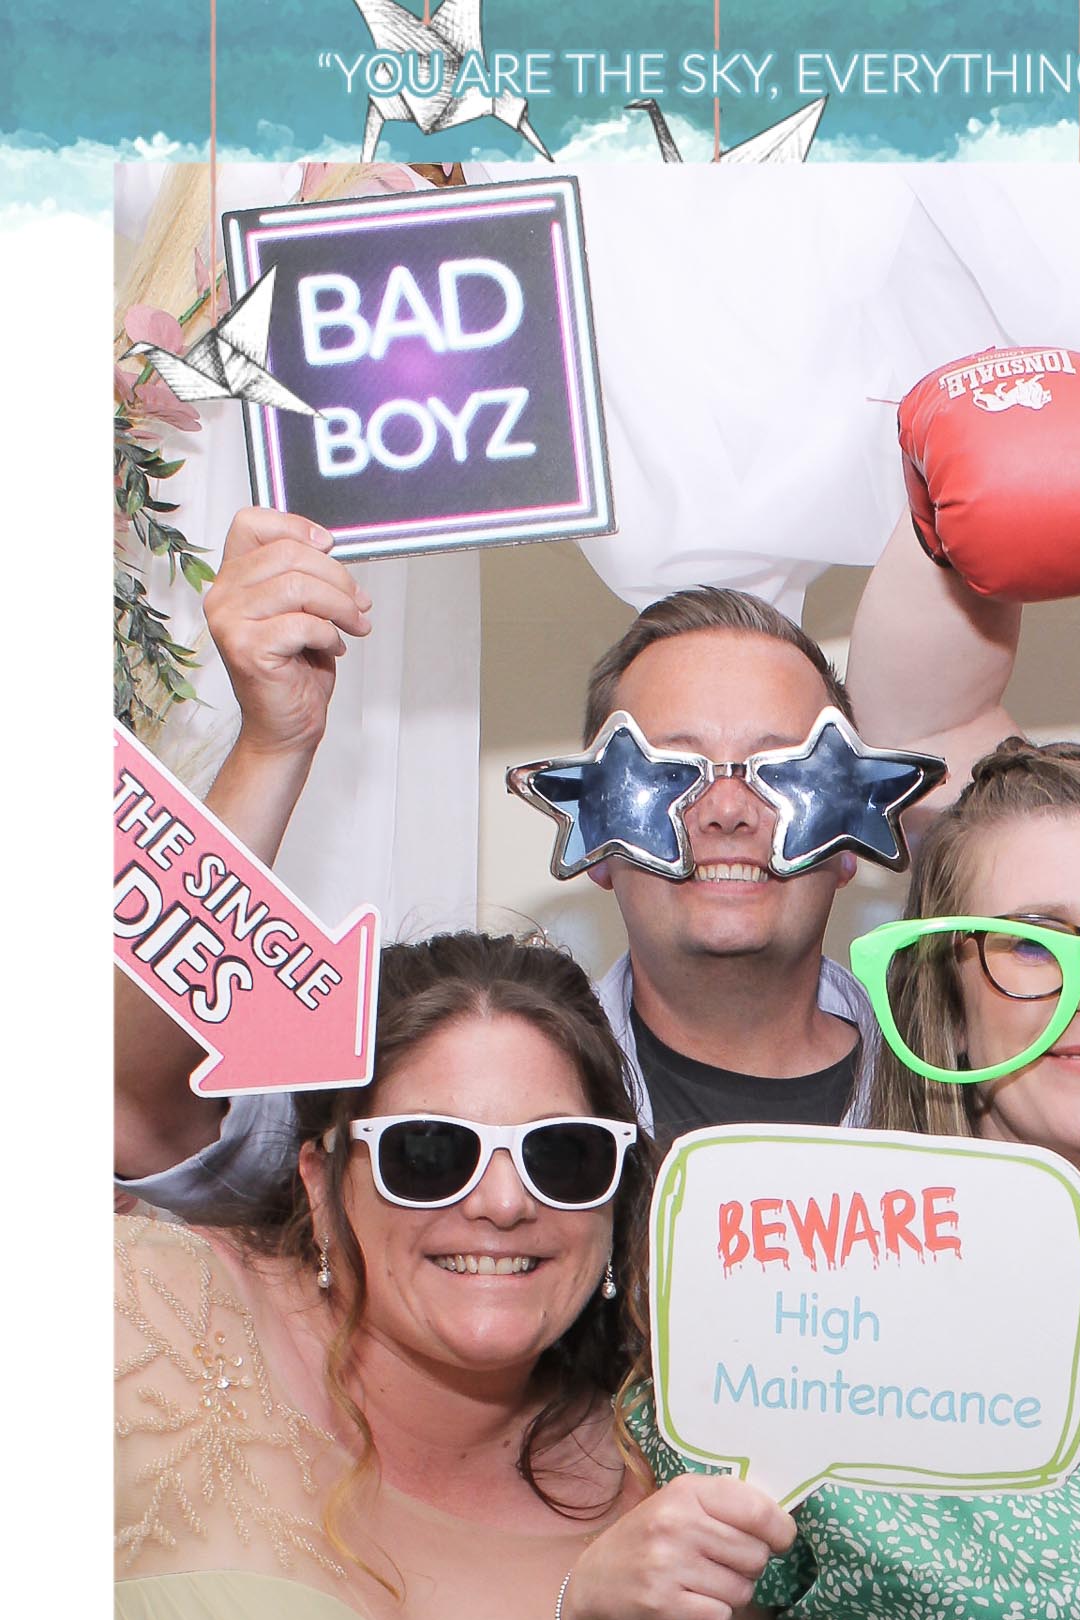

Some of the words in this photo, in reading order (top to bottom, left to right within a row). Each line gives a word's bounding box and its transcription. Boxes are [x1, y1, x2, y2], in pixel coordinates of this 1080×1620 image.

[297, 256, 525, 367] BAD
[945, 350, 1076, 399] LONSDALE
[311, 386, 537, 478] BOYZ
[114, 768, 195, 871] THE
[183, 853, 342, 1010] SINGLE
[717, 1186, 962, 1279] BEWARE
[774, 1291, 880, 1354] High
[713, 1362, 1042, 1429] Maintencance
